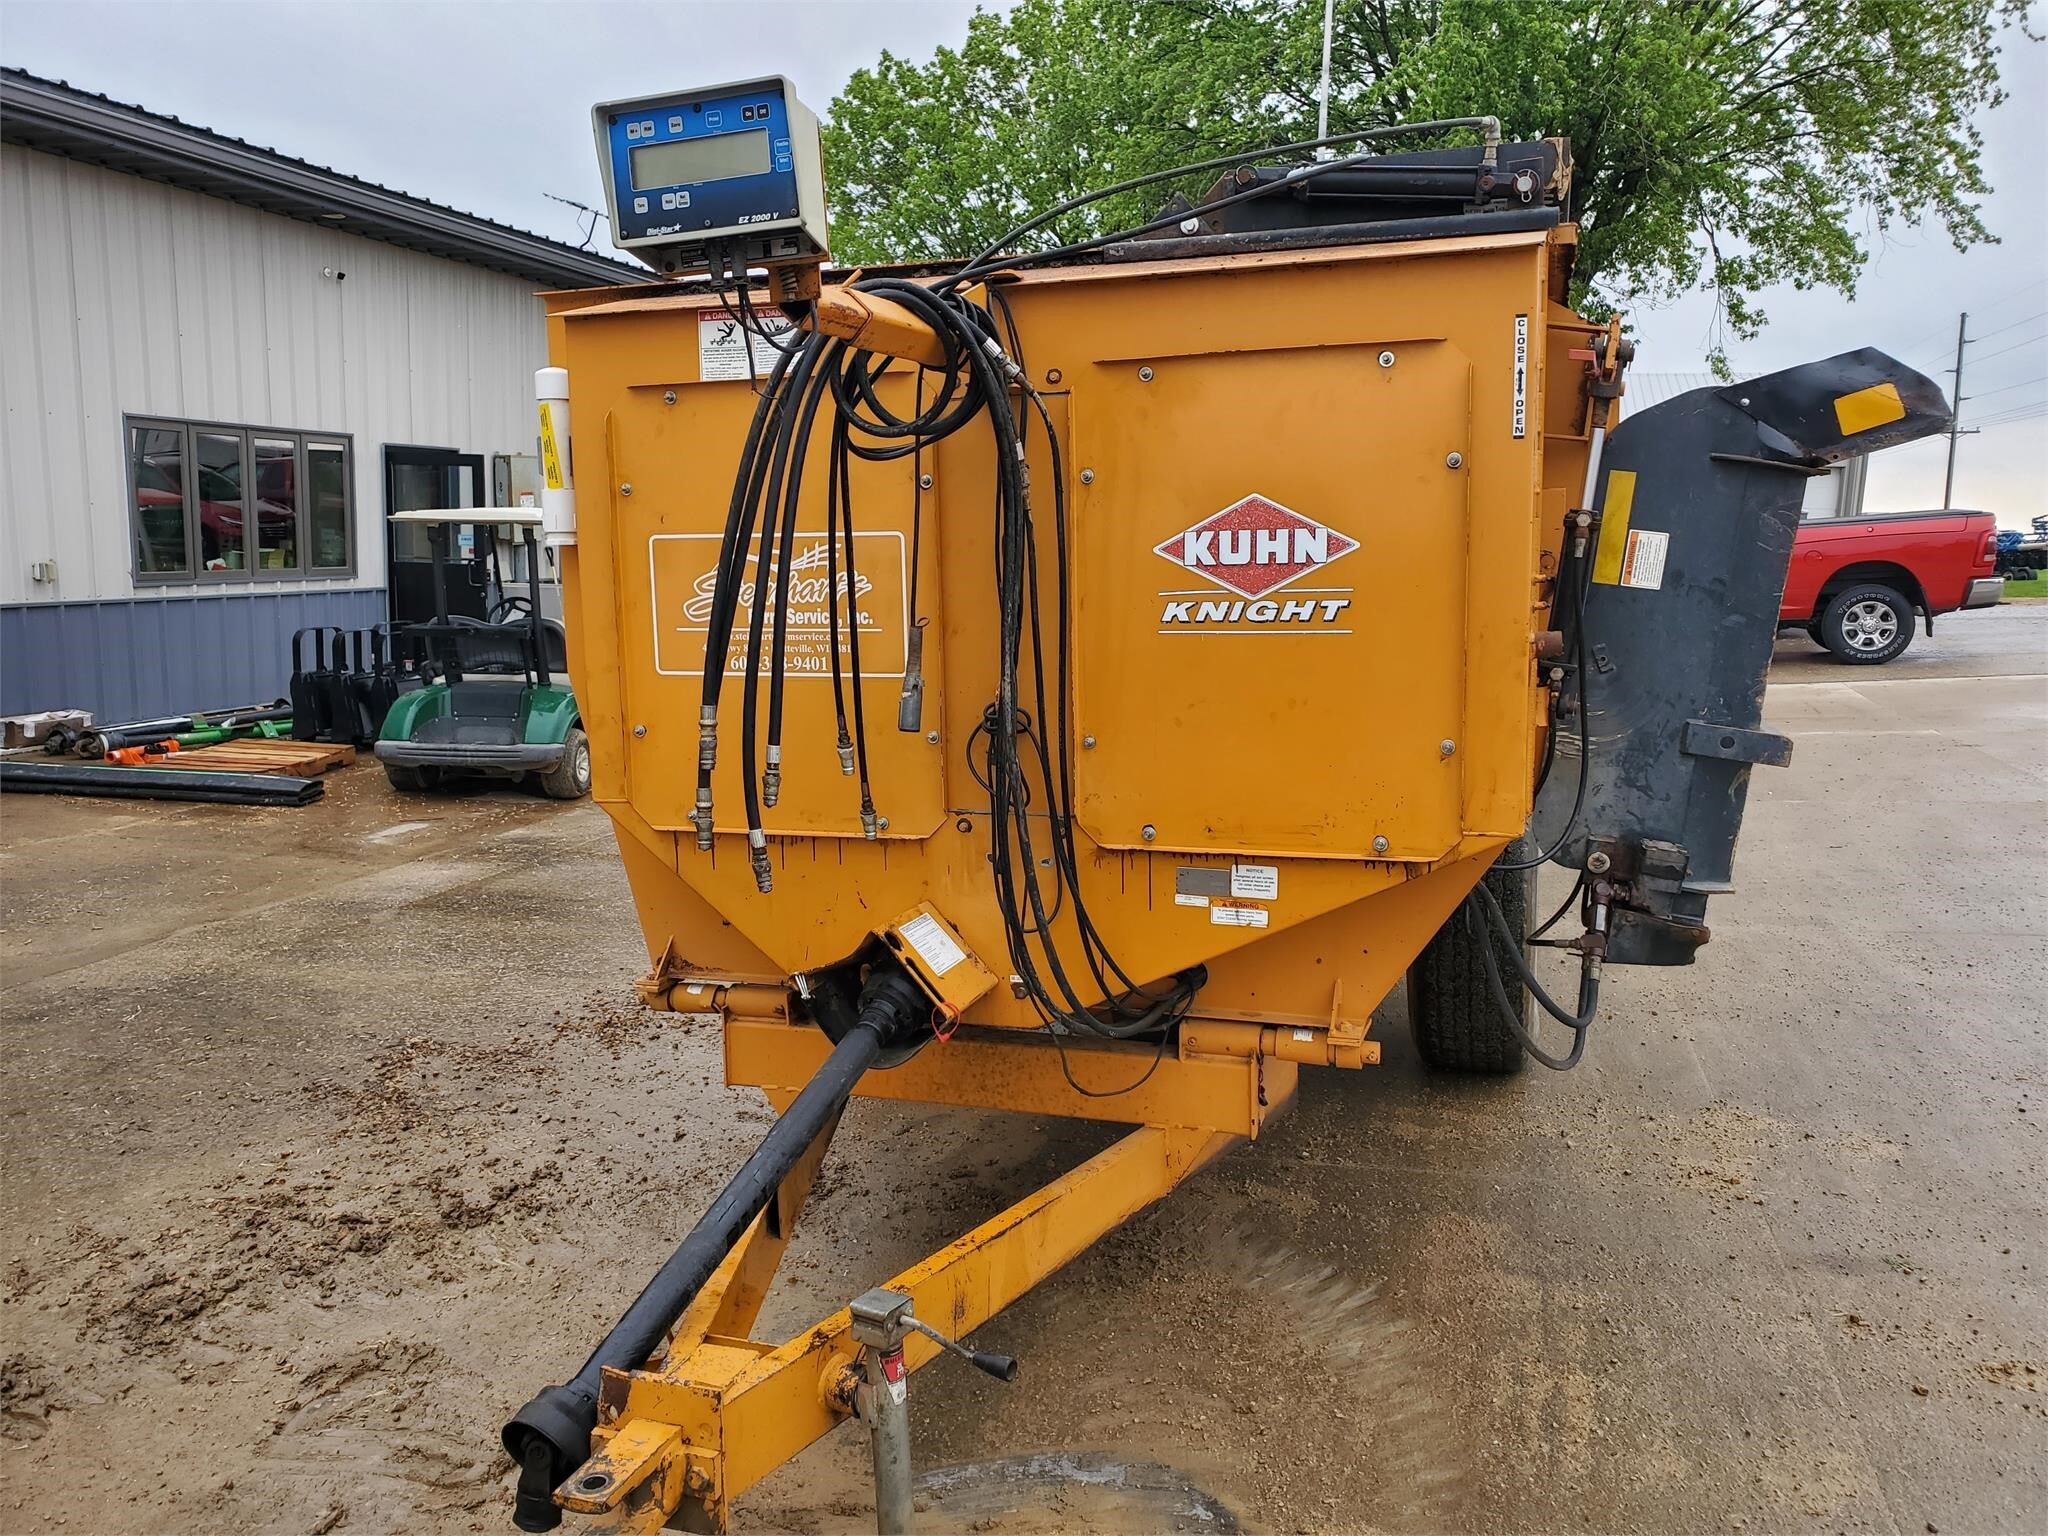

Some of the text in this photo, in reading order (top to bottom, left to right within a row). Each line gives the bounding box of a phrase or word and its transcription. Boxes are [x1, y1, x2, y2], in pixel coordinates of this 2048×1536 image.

[738, 211, 780, 225] EZ 2000 V
[1516, 318, 1526, 363] CLOSE
[1514, 399, 1525, 435] OPEN
[1183, 527, 1329, 567] KUHN
[786, 606, 844, 628] Servic,
[1159, 599, 1351, 625] KNIGHT
[730, 655, 828, 671] 60-3-9401
